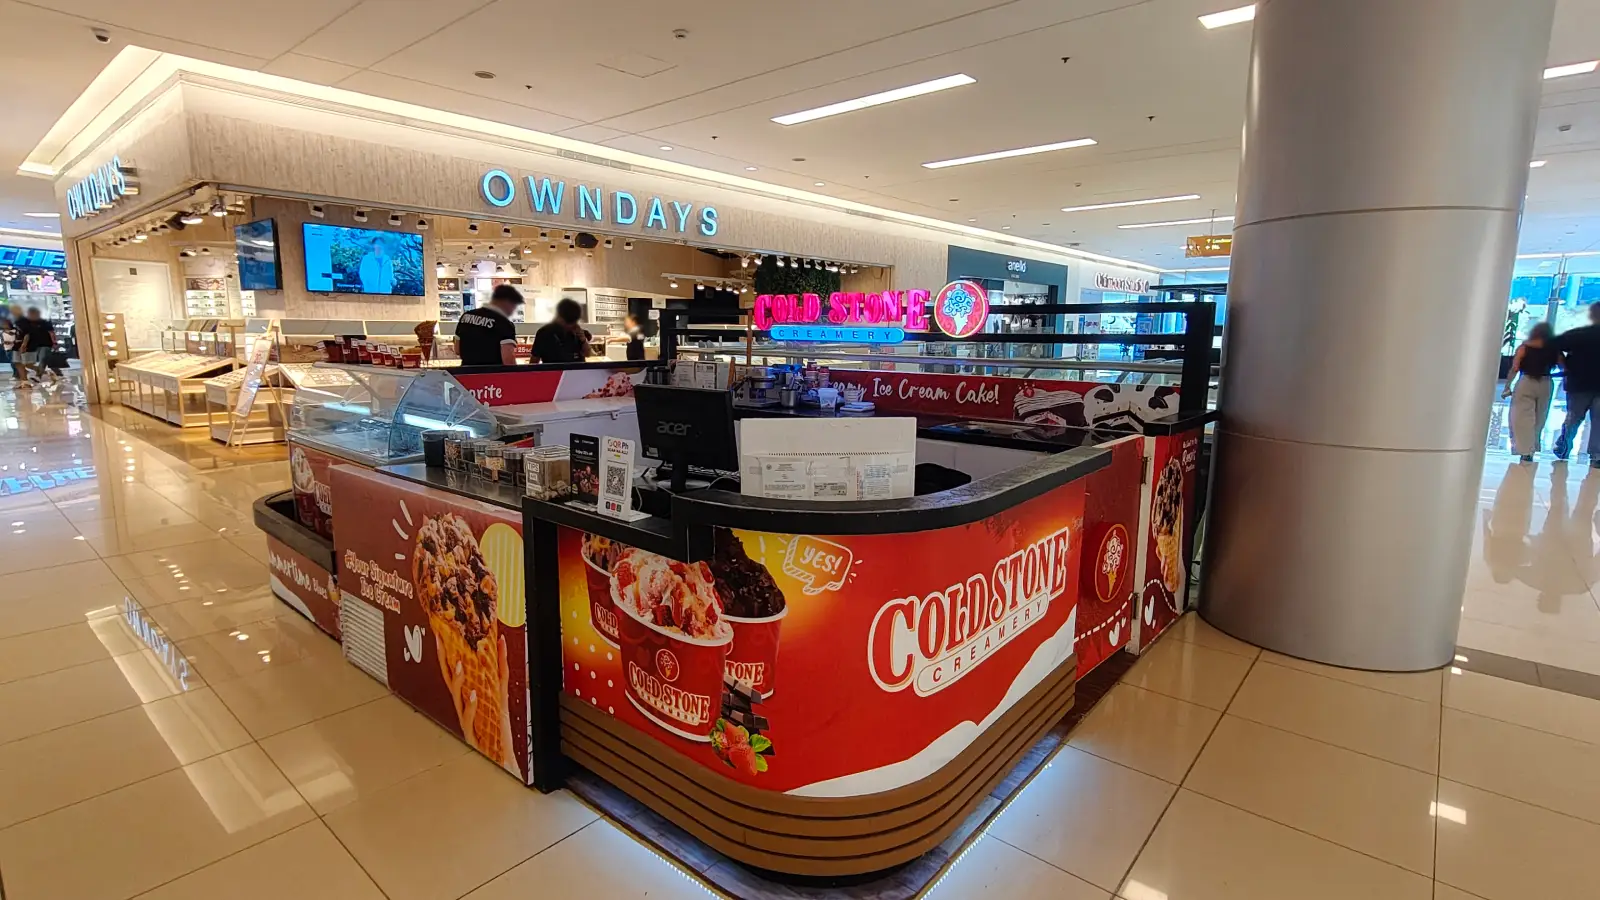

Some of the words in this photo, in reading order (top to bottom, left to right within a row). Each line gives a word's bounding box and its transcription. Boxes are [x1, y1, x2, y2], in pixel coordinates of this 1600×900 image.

[67, 155, 125, 220] OWNDAYS
[481, 169, 718, 236] OWNDAYS
[461, 314, 495, 328] OWNDAYS
[754, 294, 821, 331] COLD
[829, 289, 930, 331] STONE
[778, 329, 891, 340] CREAMERY
[873, 378, 893, 397] Ice
[898, 378, 950, 401] Cream
[956, 381, 1000, 404] Cake!
[657, 421, 692, 436] acer
[527, 462, 539, 472] TIPS
[800, 545, 843, 575] YES!
[370, 560, 414, 600] Signature
[595, 603, 619, 629] COLD
[871, 576, 988, 688] COLD
[989, 527, 1068, 622] STONE
[933, 600, 1043, 683] CREAMERY
[629, 661, 662, 700] COLD
[663, 684, 710, 723] STONE
